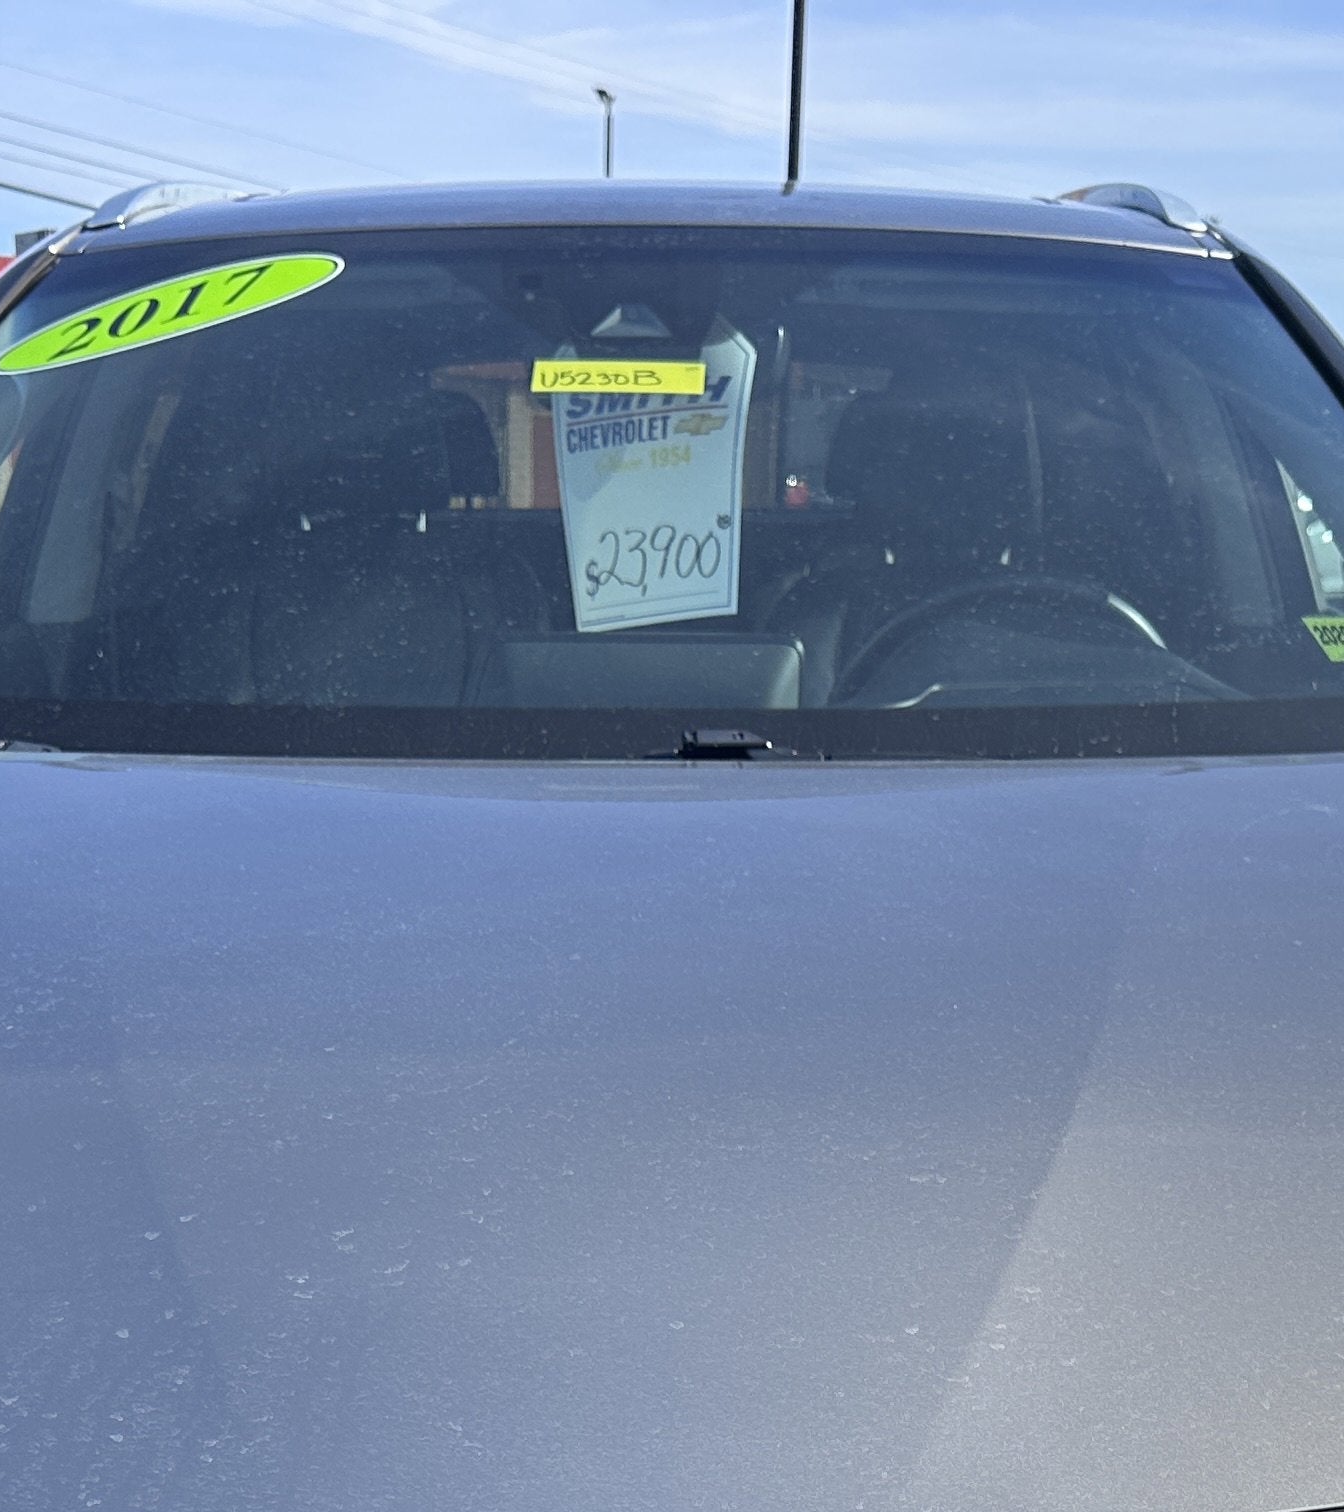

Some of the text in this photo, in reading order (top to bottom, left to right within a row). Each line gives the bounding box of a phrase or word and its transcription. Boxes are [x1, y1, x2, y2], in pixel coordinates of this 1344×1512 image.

[45, 262, 275, 363] 2017
[539, 369, 664, 389] U5230B
[566, 415, 672, 455] CHEVROLET
